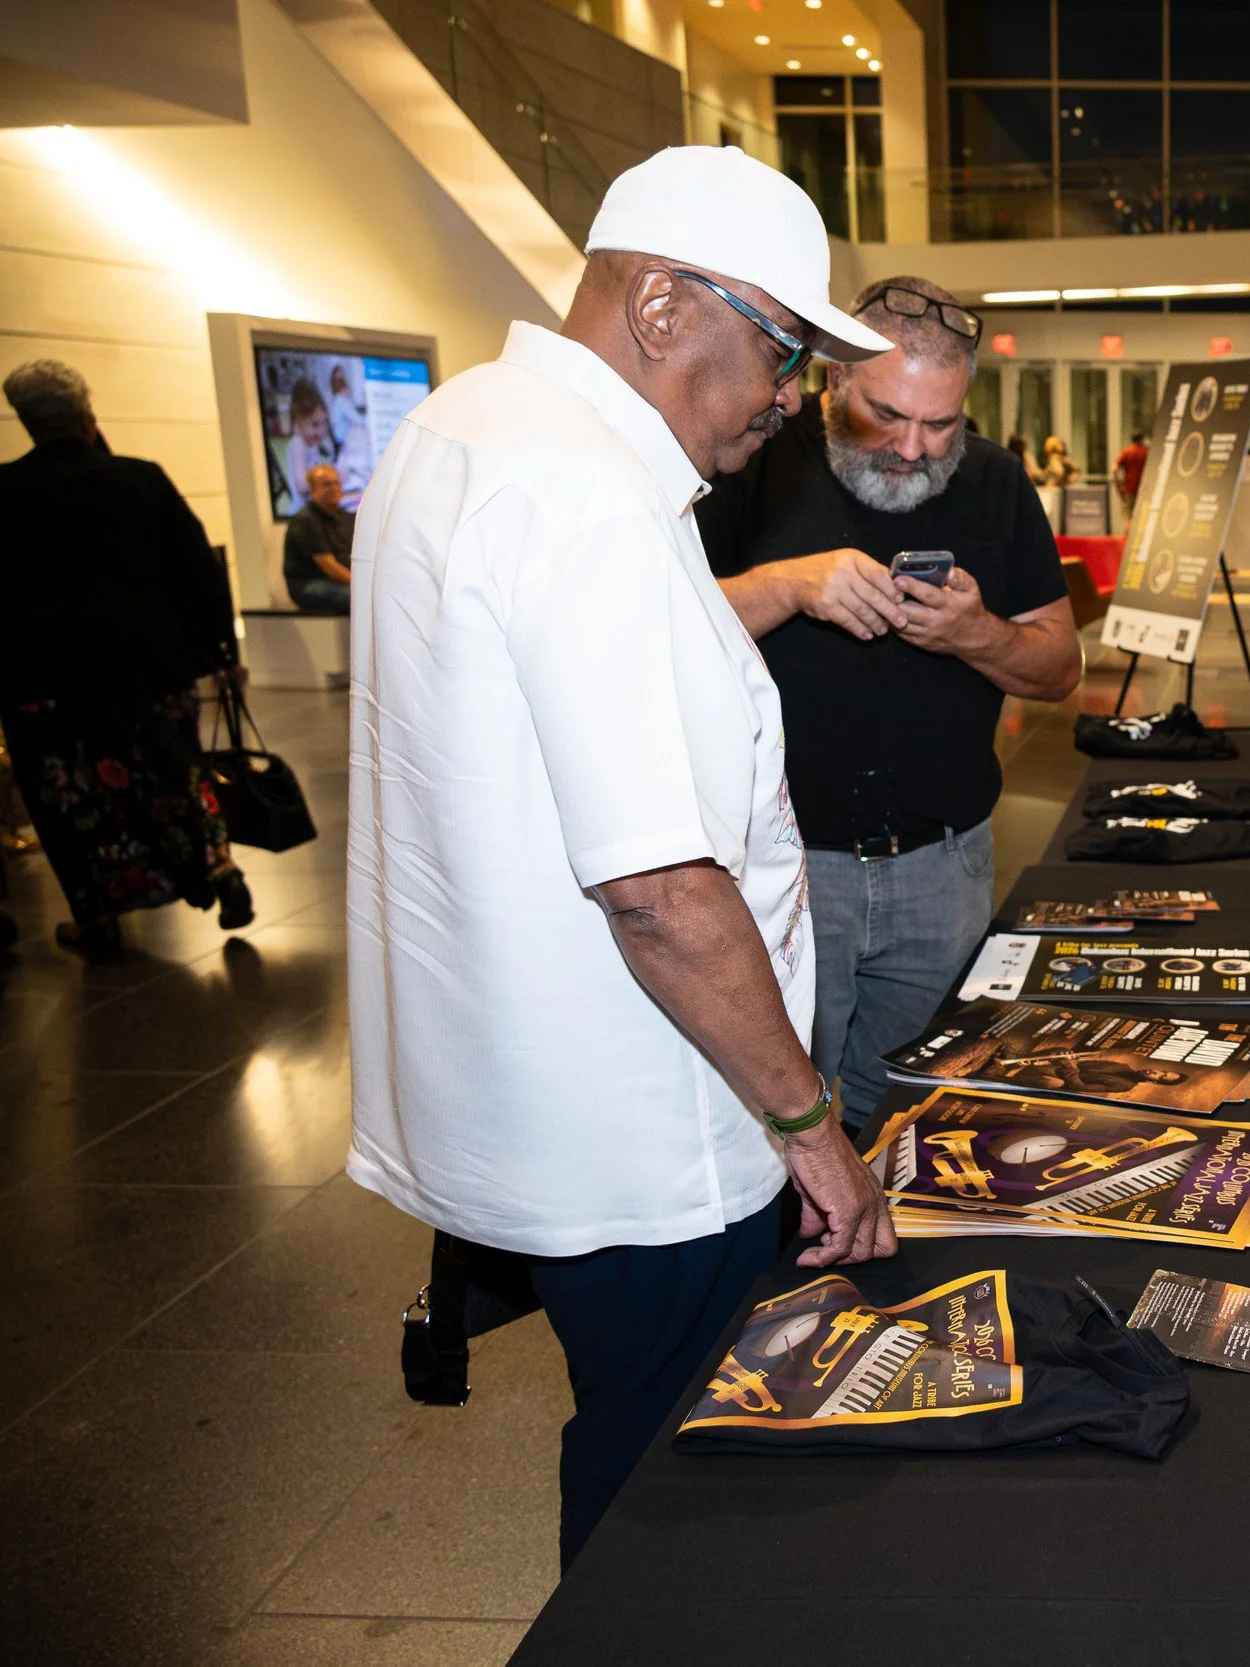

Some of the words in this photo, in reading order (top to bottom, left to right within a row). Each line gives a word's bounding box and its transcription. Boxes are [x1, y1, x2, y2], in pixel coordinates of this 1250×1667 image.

[1196, 1130, 1246, 1183] INTERNATIONAL
[1182, 1182, 1212, 1204] JAZZ
[1169, 1202, 1201, 1224] SERIES
[973, 1319, 995, 1347] 2026
[903, 1343, 929, 1371] COLUMBUS
[888, 1369, 908, 1392] MUSEUM
[913, 1372, 924, 1390] FOR
[951, 1357, 975, 1399] SERIES
[874, 1399, 884, 1410] ART
[881, 1391, 891, 1401] OF
[912, 1390, 922, 1408] JAZZ
[927, 1387, 937, 1408] TRIBE
